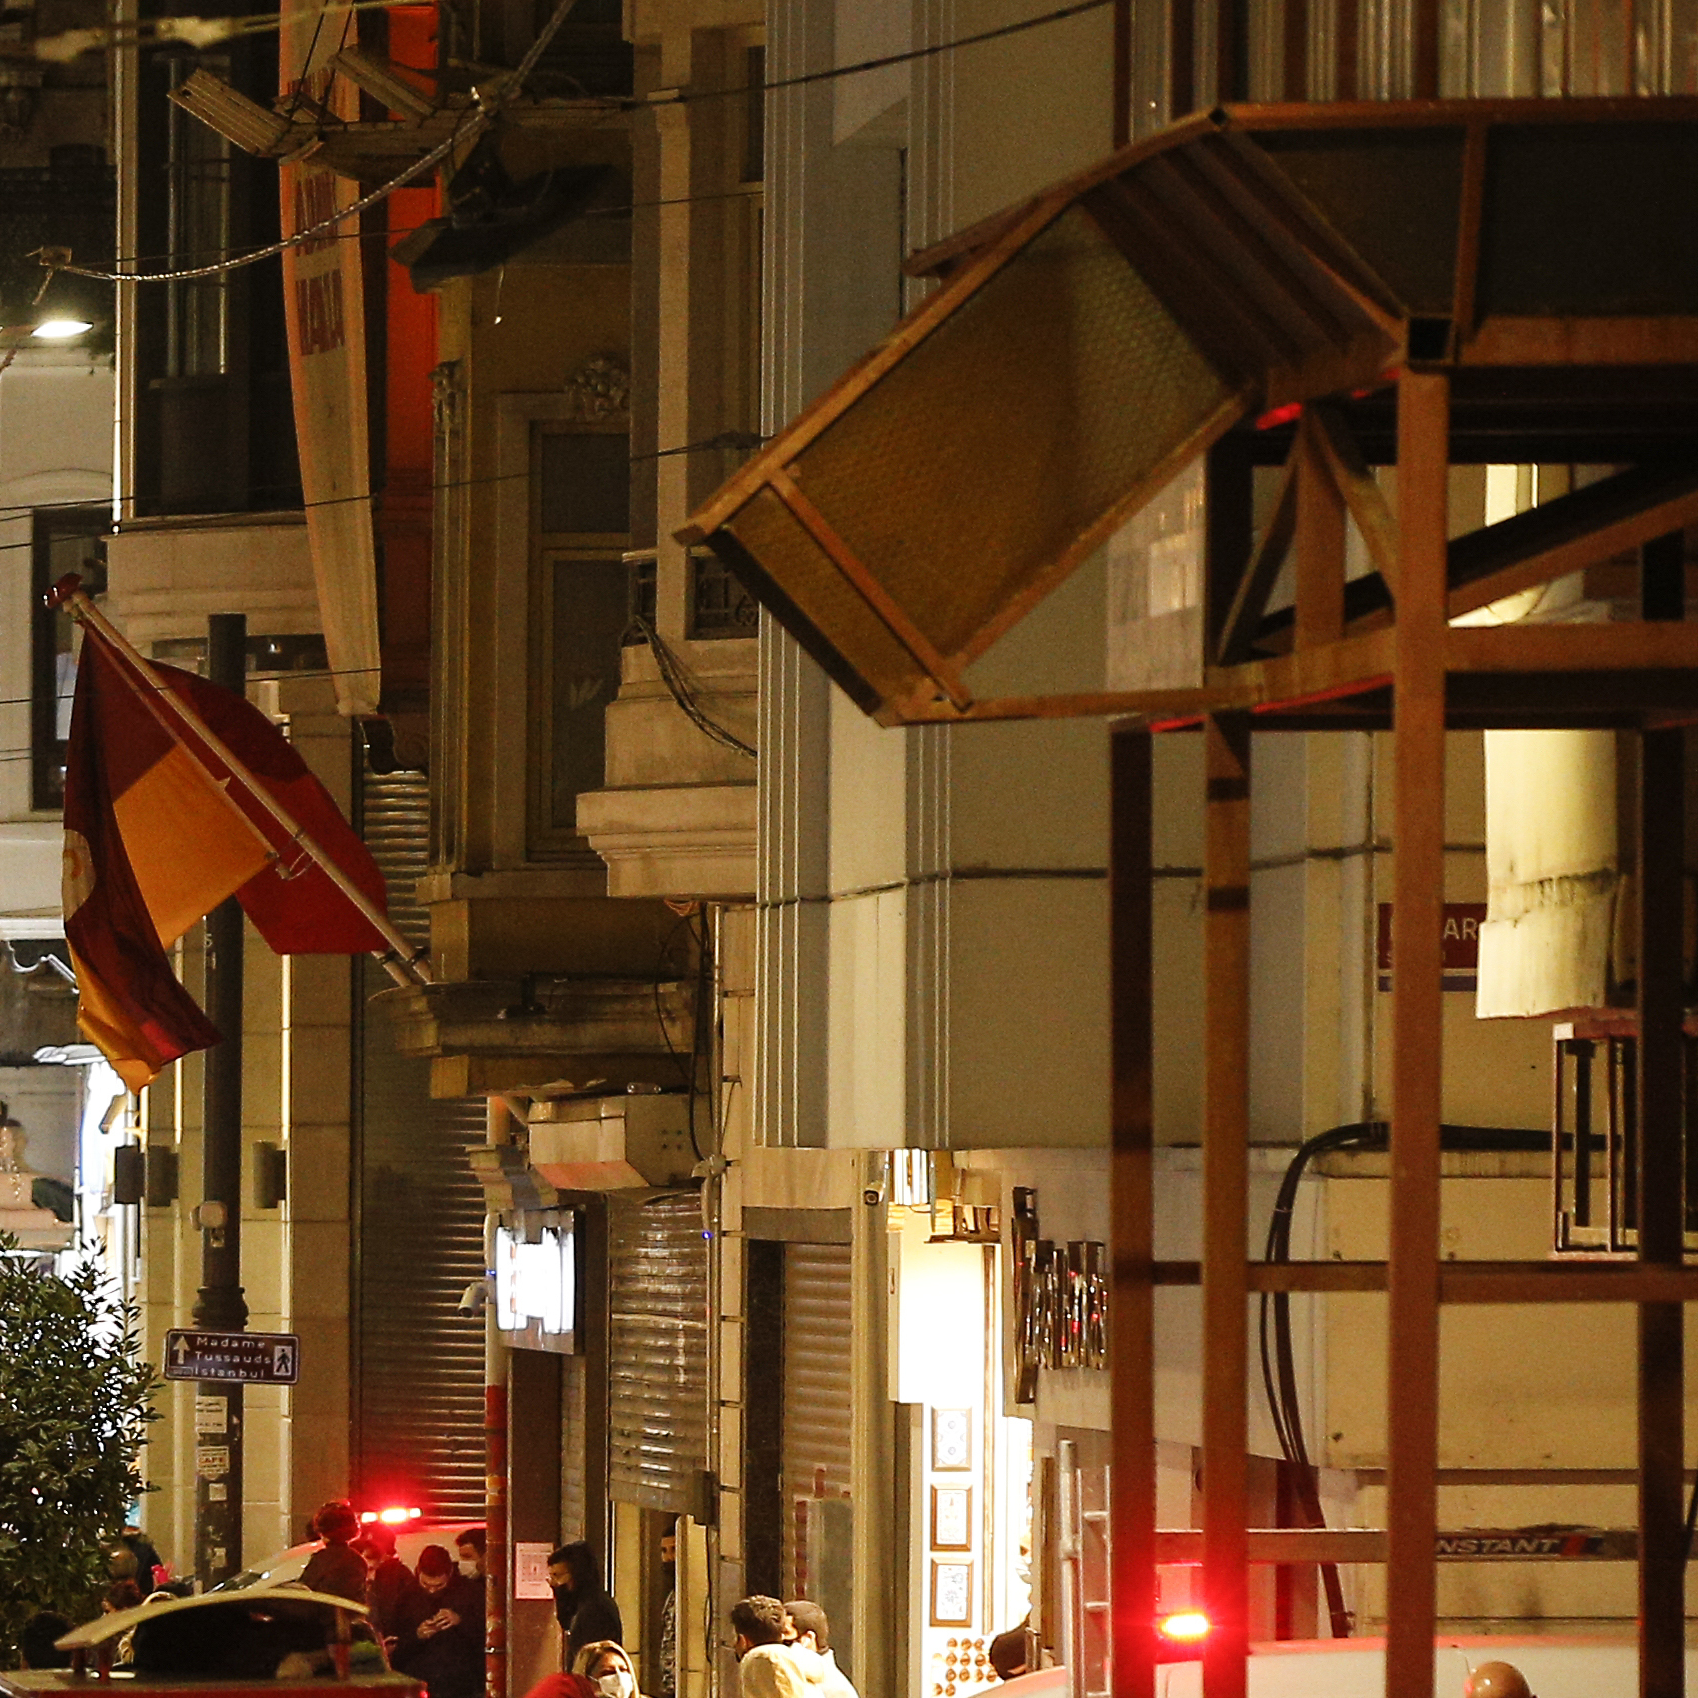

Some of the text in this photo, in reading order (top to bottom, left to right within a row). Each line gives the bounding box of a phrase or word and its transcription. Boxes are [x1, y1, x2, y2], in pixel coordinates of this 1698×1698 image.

[197, 1337, 266, 1348] Madame
[195, 1351, 271, 1364] Tussauds
[1436, 1538, 1560, 1554] NSTANT
